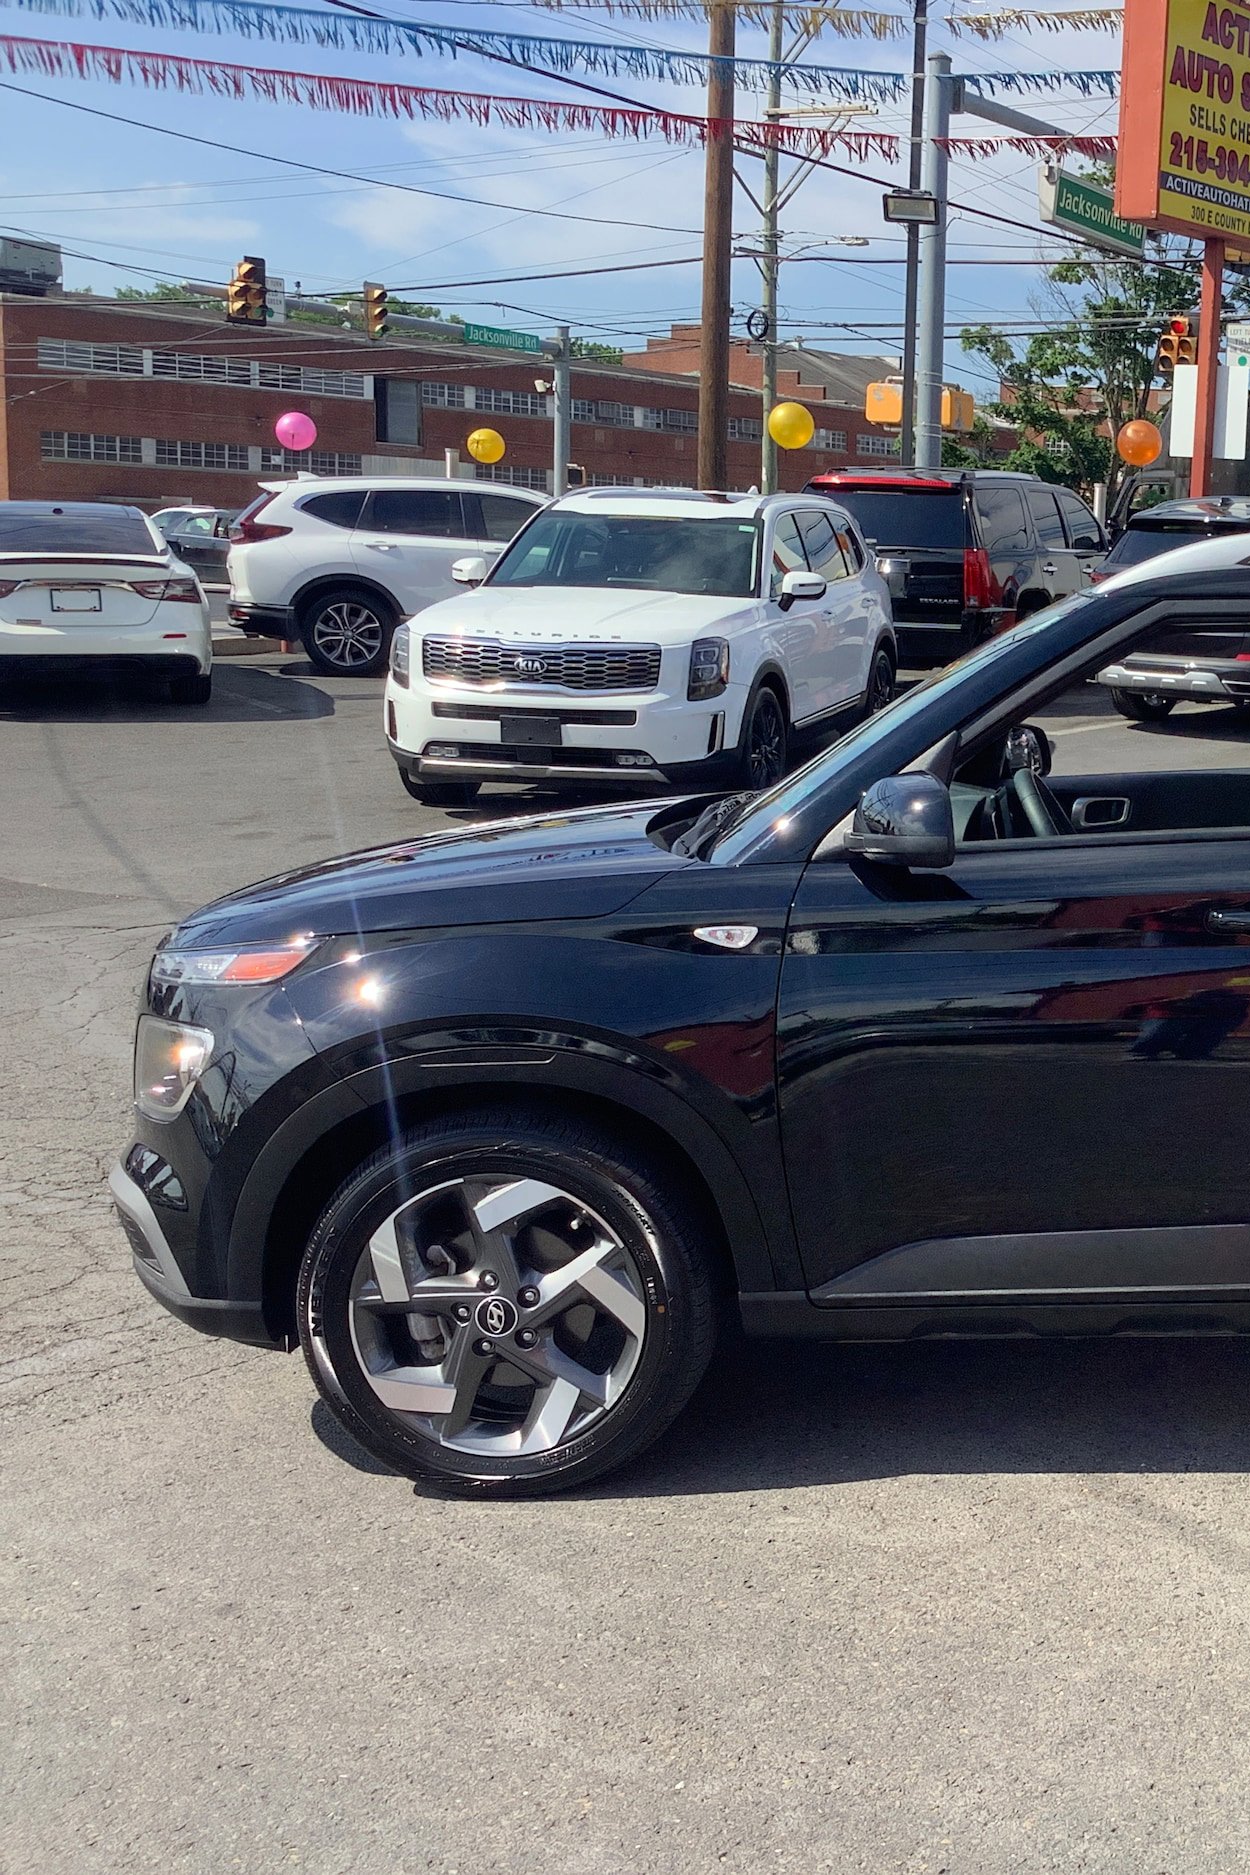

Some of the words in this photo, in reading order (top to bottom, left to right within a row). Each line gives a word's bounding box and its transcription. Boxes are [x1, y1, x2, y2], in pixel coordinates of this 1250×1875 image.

[1169, 45, 1234, 104] AUTO
[1189, 104, 1226, 137] SELLS
[1059, 188, 1128, 233] Jacksonville
[1128, 222, 1143, 240] Rd
[1191, 206, 1205, 221] 300
[1207, 210, 1213, 223] E
[1214, 213, 1246, 233] COUNTY
[469, 325, 524, 348] Jacksonville
[525, 335, 537, 348] Rd
